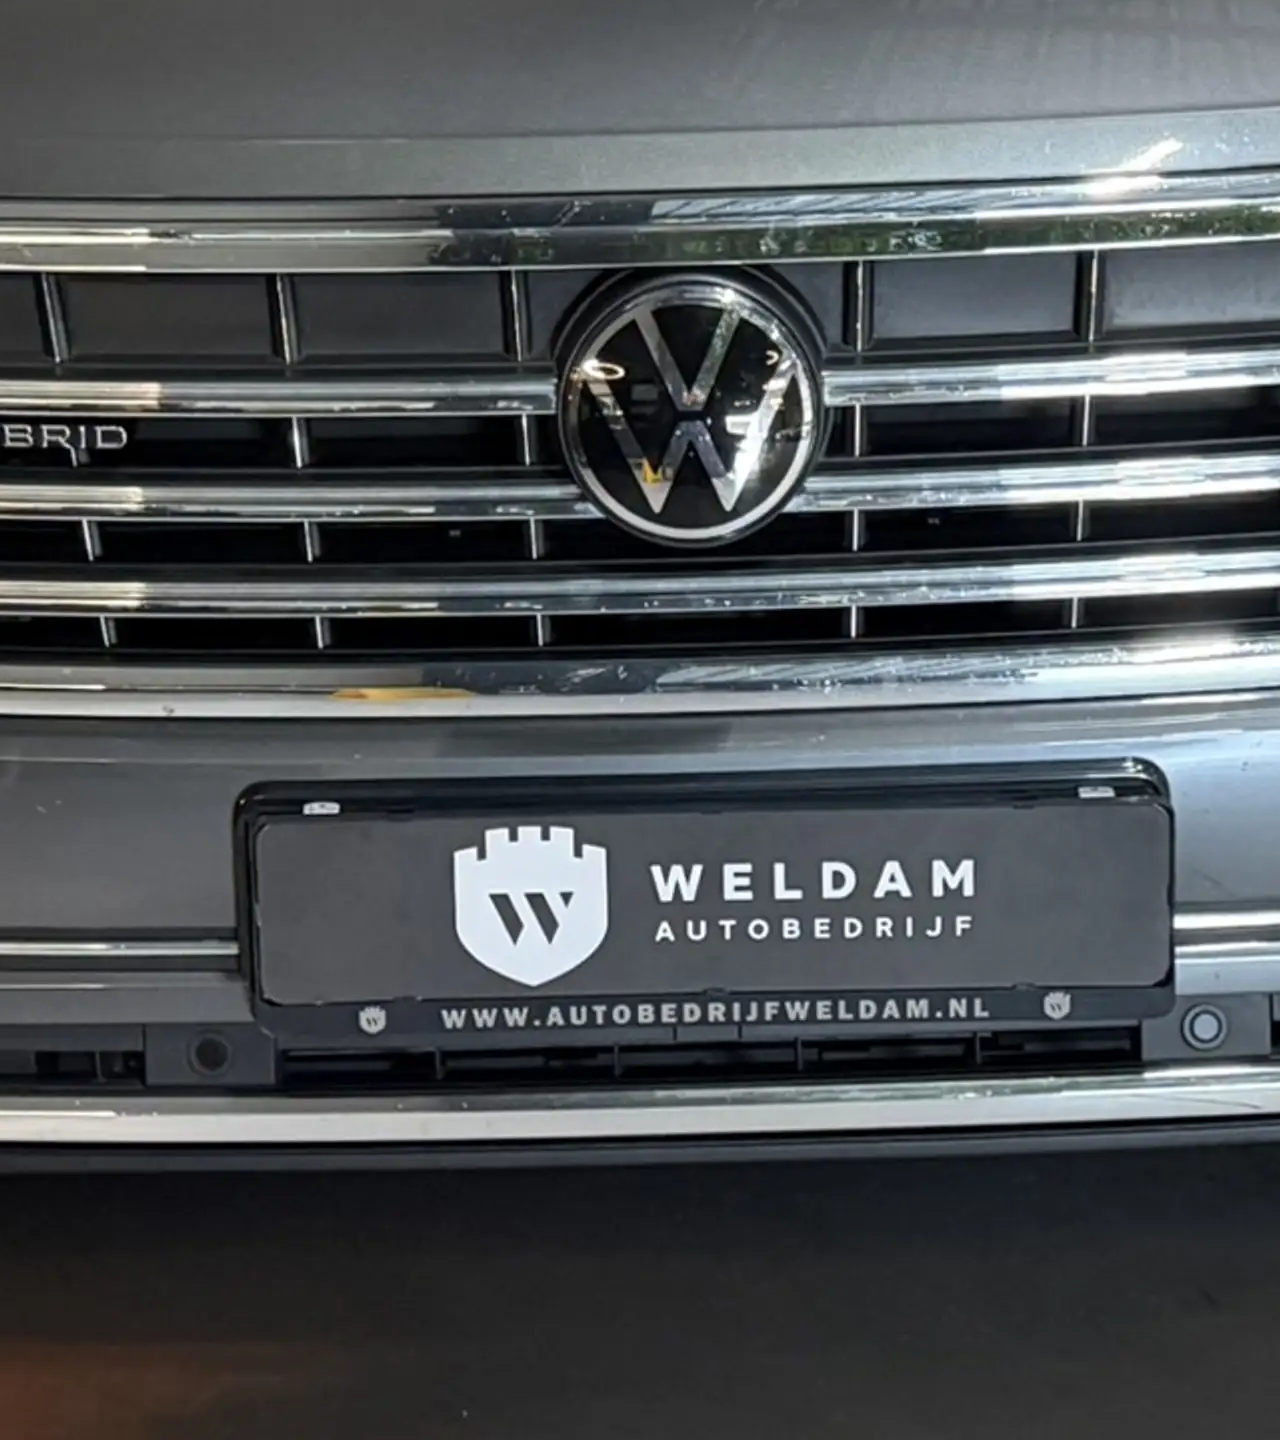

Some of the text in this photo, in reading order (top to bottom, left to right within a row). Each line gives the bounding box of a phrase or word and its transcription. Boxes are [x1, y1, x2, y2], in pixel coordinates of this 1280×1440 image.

[570, 300, 800, 515] VW
[651, 859, 976, 902] WELDAM
[655, 915, 973, 943] AUTOBEDRIJF
[441, 998, 990, 1030] WWW.AUTOBEDRIJFWELDAM.NL
